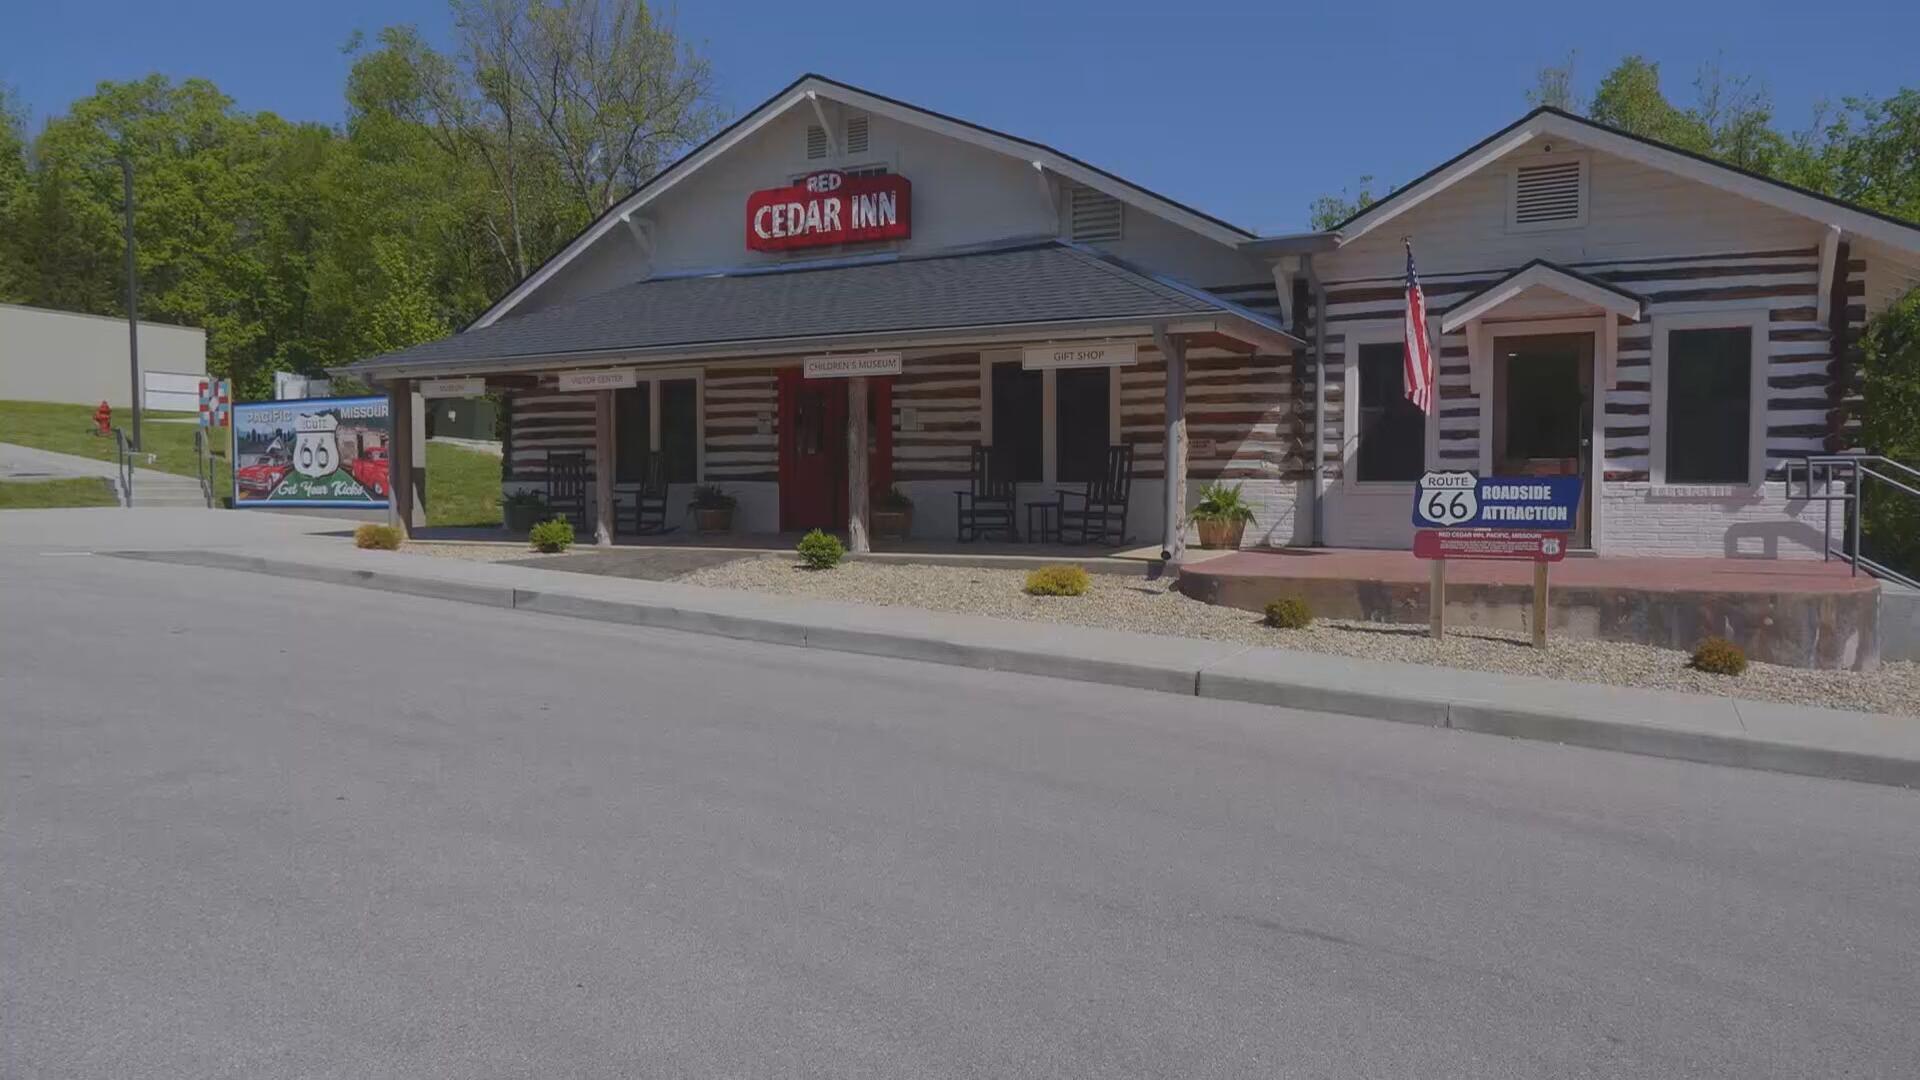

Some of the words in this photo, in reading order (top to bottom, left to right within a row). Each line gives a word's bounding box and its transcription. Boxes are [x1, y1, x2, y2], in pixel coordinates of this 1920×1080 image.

[806, 173, 842, 193] RED
[754, 197, 842, 239] CEDAR
[851, 190, 896, 230] INN
[858, 358, 897, 369] MUSEUM
[1053, 351, 1074, 361] GIFT
[1077, 350, 1105, 361] SHOP
[247, 409, 293, 424] PACIFIC
[340, 404, 389, 419] MISSOUR
[300, 438, 330, 469] 66
[277, 481, 298, 496] Get
[300, 481, 329, 497] Your
[331, 480, 366, 496] Kicks
[1428, 476, 1468, 487] ROUTE
[1482, 485, 1551, 500] ROADSIDE
[1428, 491, 1468, 519] 66
[1482, 505, 1567, 521] ATTRACTION
